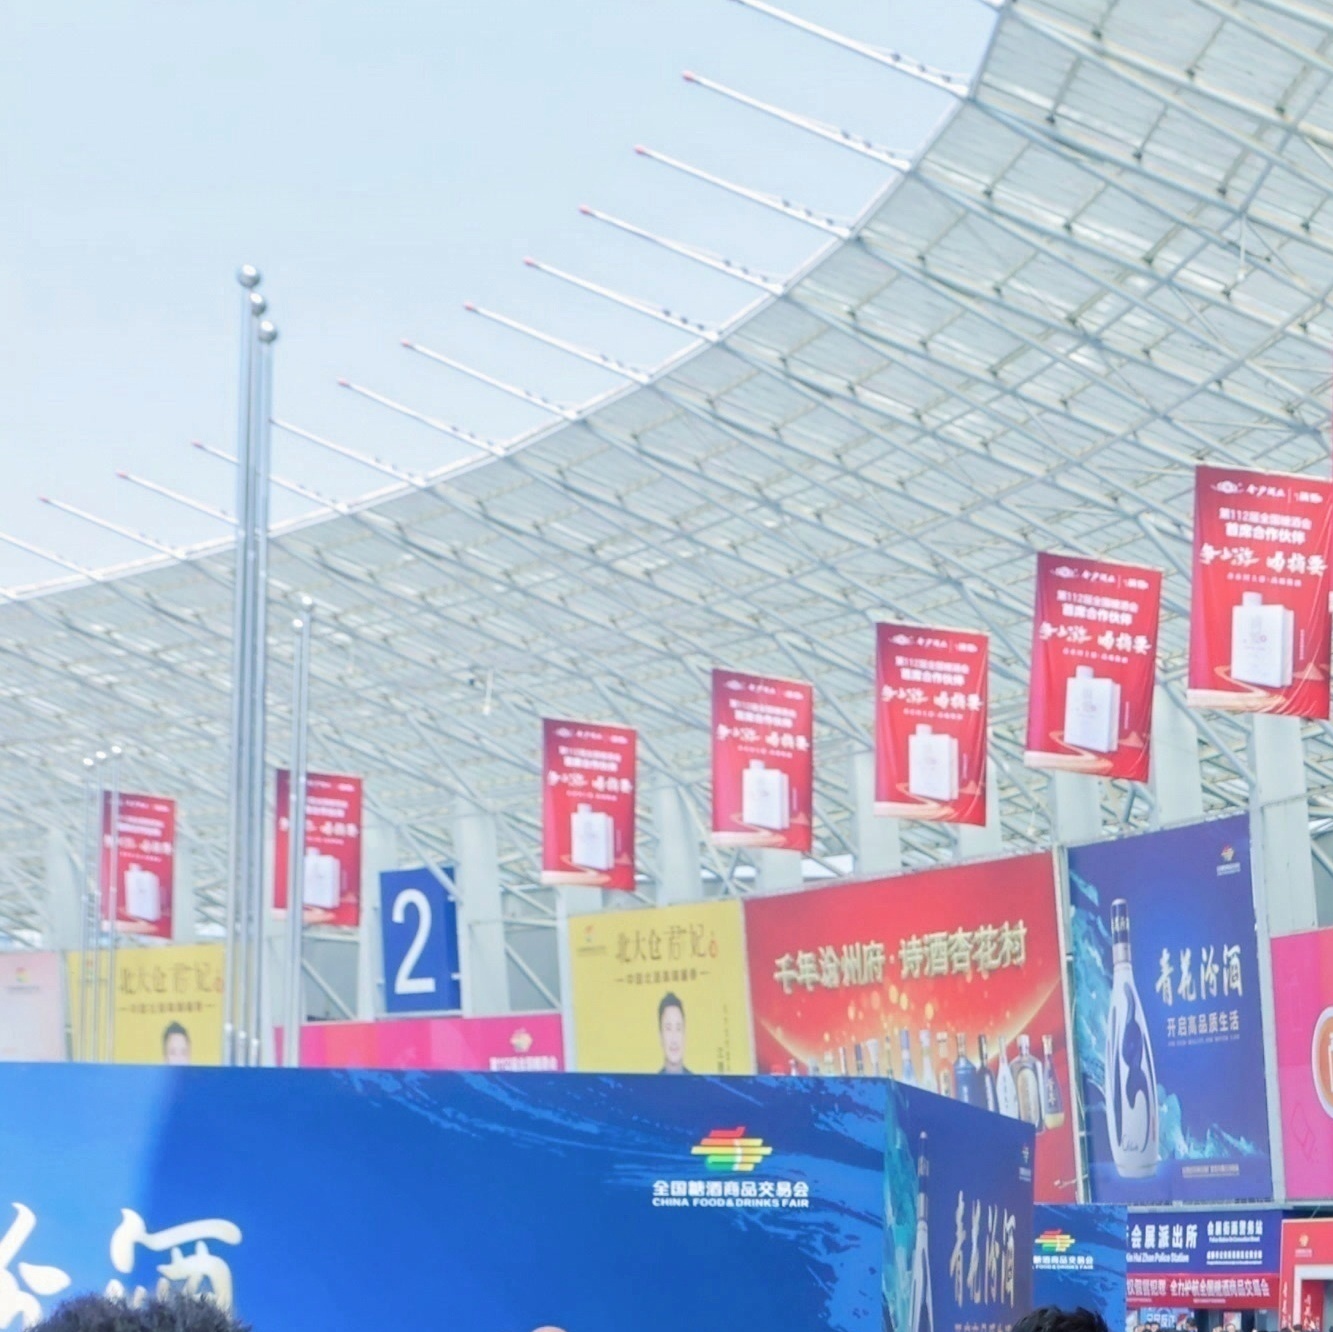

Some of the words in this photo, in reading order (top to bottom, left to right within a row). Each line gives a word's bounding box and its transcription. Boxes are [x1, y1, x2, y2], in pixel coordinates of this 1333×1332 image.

[391, 888, 436, 995] 2
[1156, 944, 1243, 1006] 青花汾酒
[1167, 1009, 1240, 1038] 开启高品质生活
[652, 1180, 809, 1198] 全国糖酒商品交易会
[652, 1197, 690, 1207] CHINA
[781, 1198, 809, 1208] FAIR
[1126, 1223, 1198, 1249] 会展派出所
